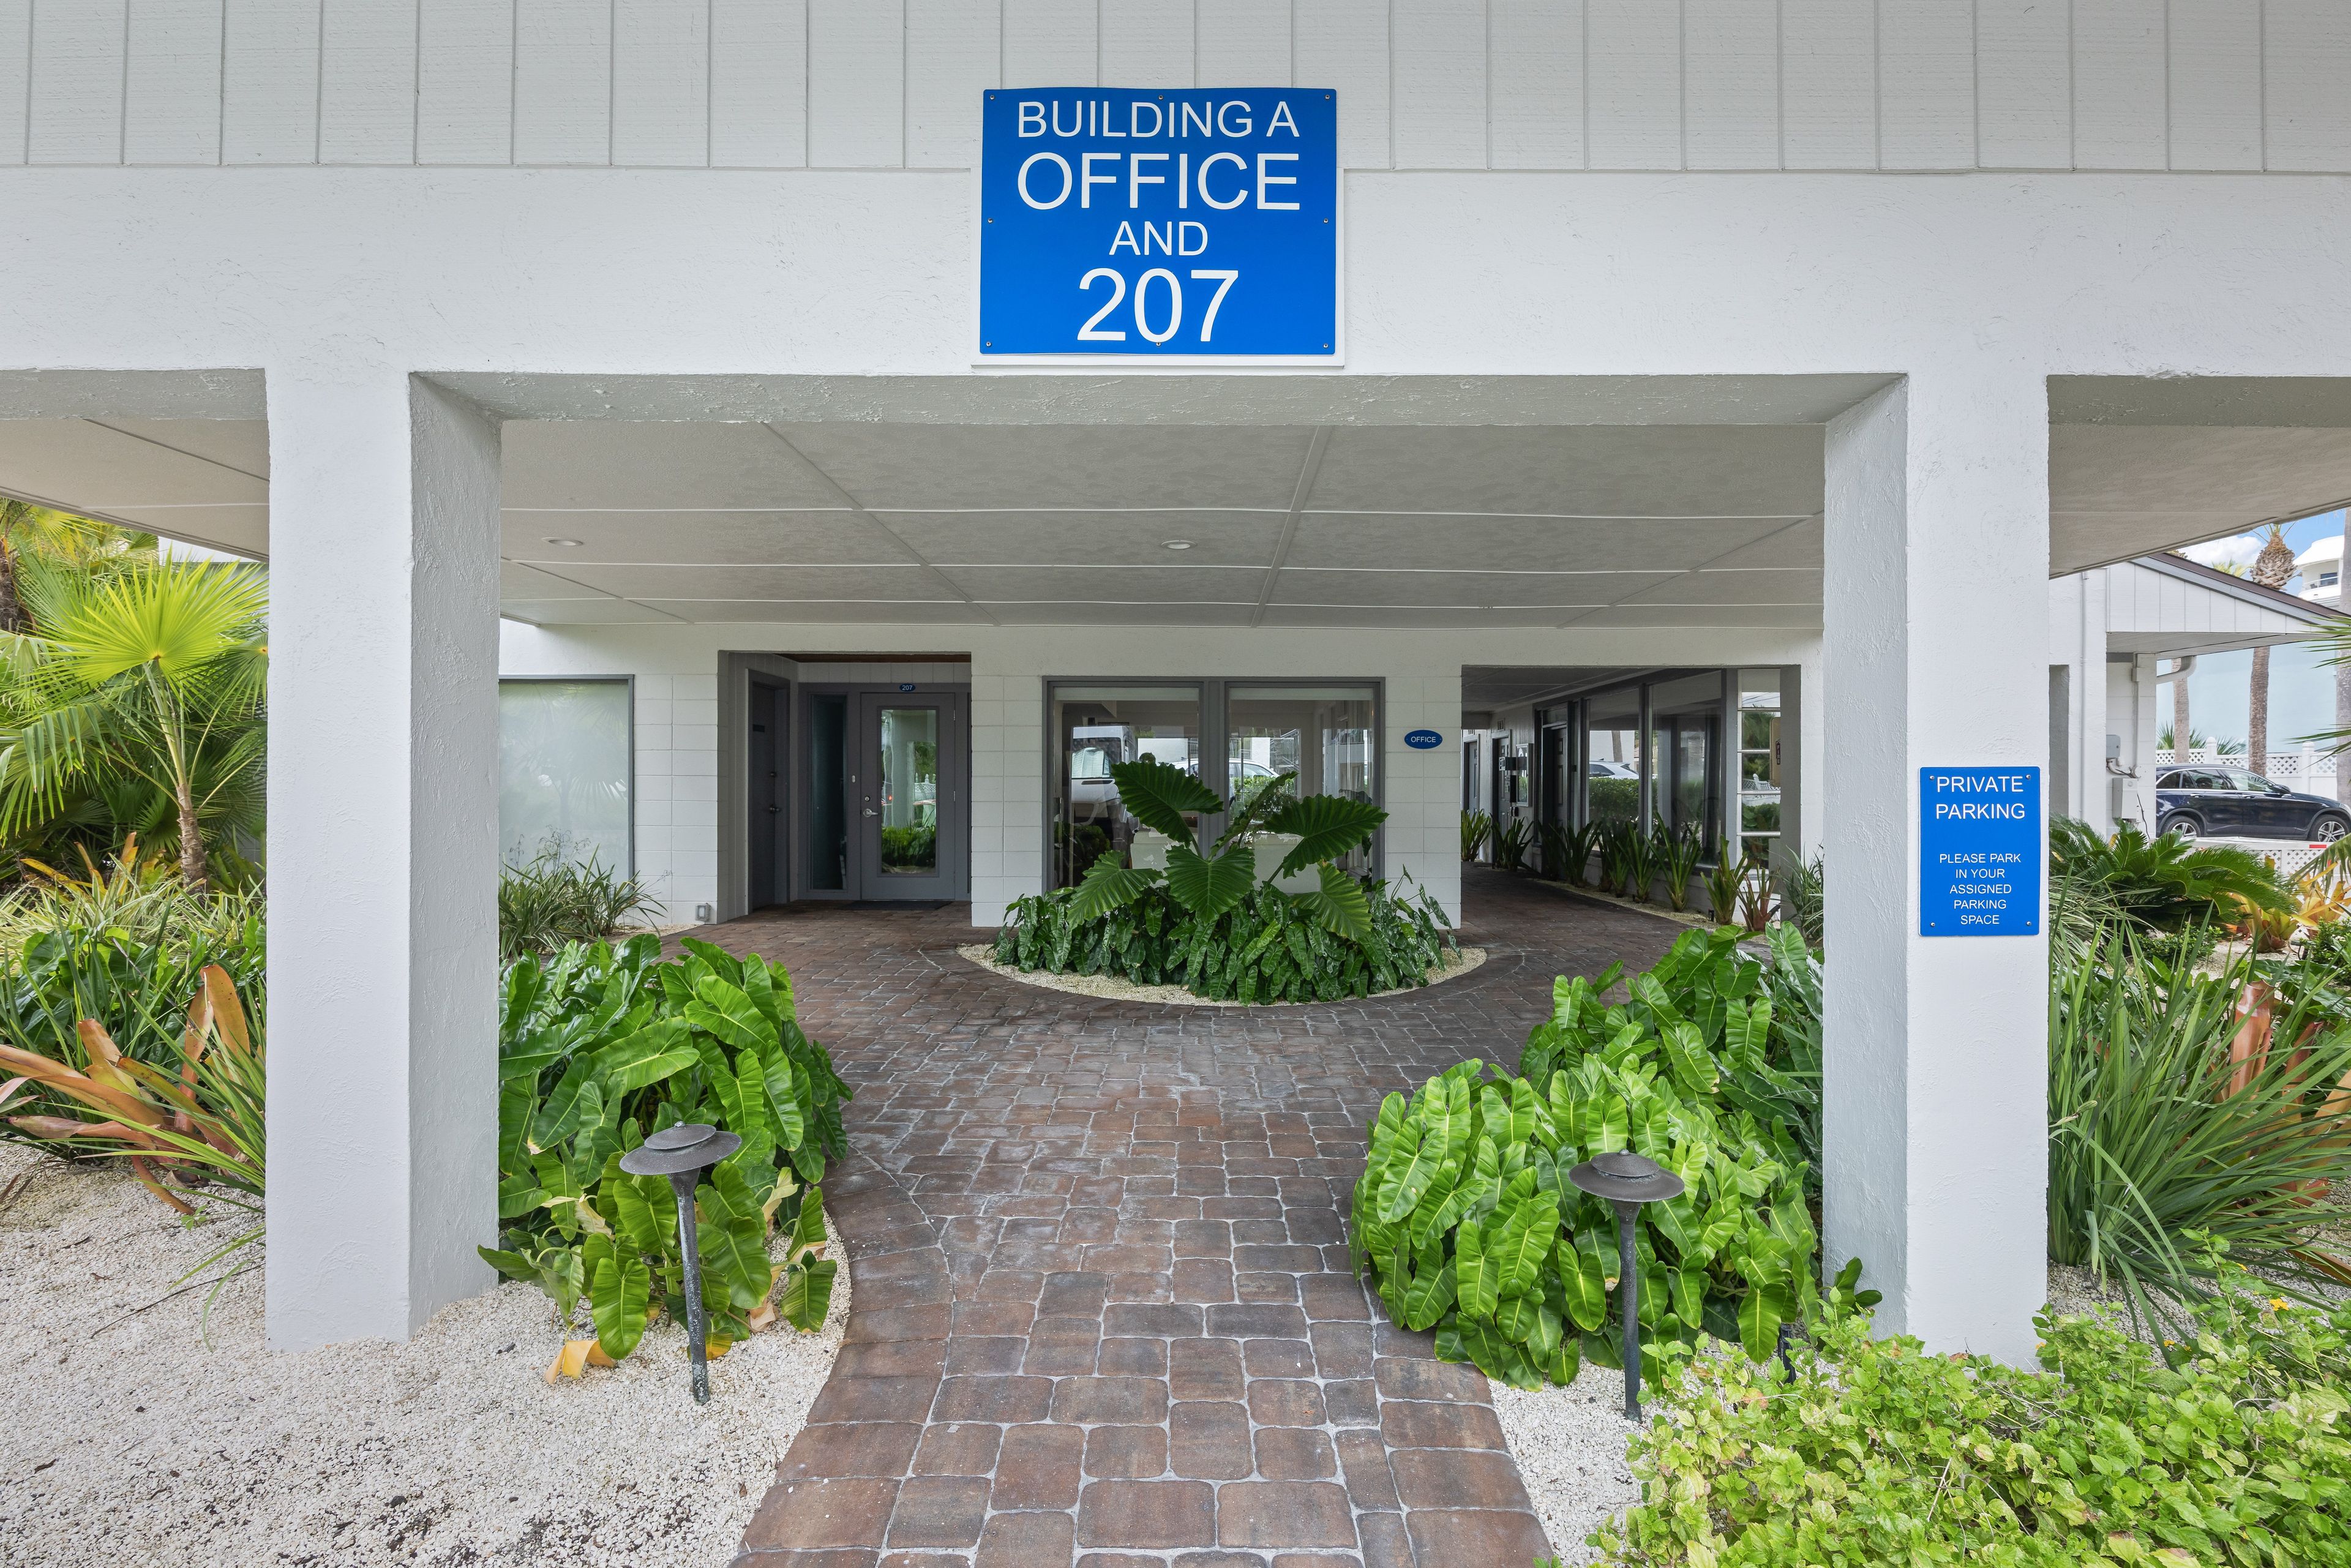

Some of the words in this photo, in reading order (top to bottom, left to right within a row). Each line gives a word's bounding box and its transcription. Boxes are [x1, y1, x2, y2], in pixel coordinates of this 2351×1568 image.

[1018, 100, 1252, 138] BUILDING
[1266, 101, 1300, 137] A
[1018, 152, 1300, 210] OFFICE
[1109, 220, 1208, 256] AND
[1077, 268, 1239, 342] 207
[1937, 776, 2023, 793] PRIVATE
[1936, 803, 2025, 819] PARKING
[1940, 853, 1986, 863] PLEASE
[1990, 853, 2021, 863] PARK
[1955, 869, 1967, 879] IN
[1970, 868, 2005, 879] YOUR
[1949, 884, 2012, 894] ASSIGNED
[1954, 899, 2006, 909] PARKING
[1960, 915, 2000, 925] SPACE
